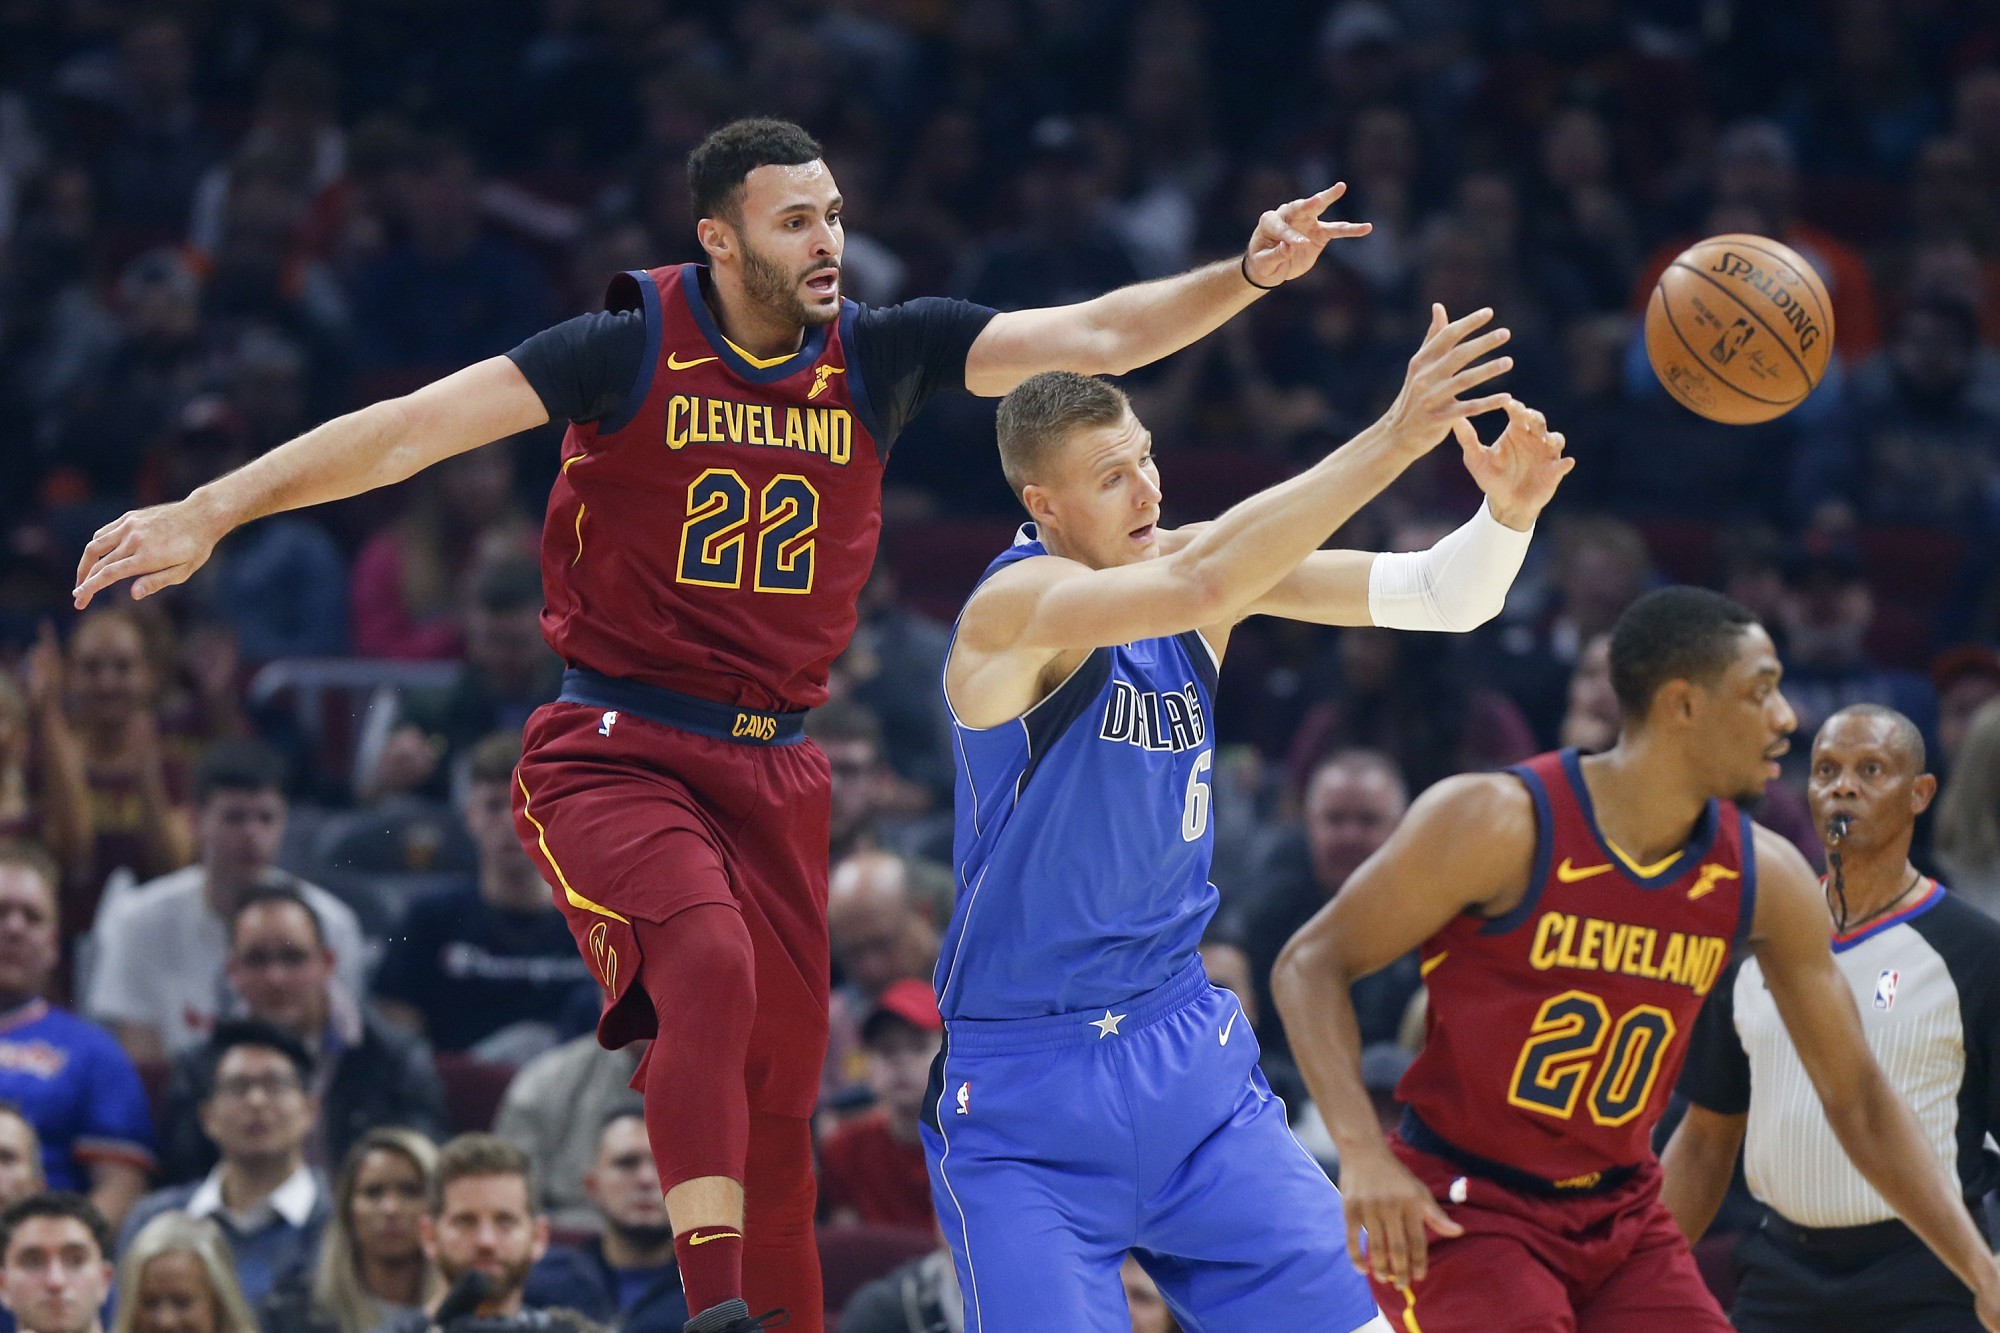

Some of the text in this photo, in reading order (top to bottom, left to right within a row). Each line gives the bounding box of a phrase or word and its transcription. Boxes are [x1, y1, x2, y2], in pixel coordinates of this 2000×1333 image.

[1711, 252, 1820, 354] SPALDING
[665, 394, 852, 466] CLEVELAND
[675, 468, 820, 595] 22
[731, 712, 778, 741] CAVS
[1182, 749, 1212, 842] 6
[1528, 911, 1727, 996] CLEVELAND
[1507, 989, 1677, 1127] 20
